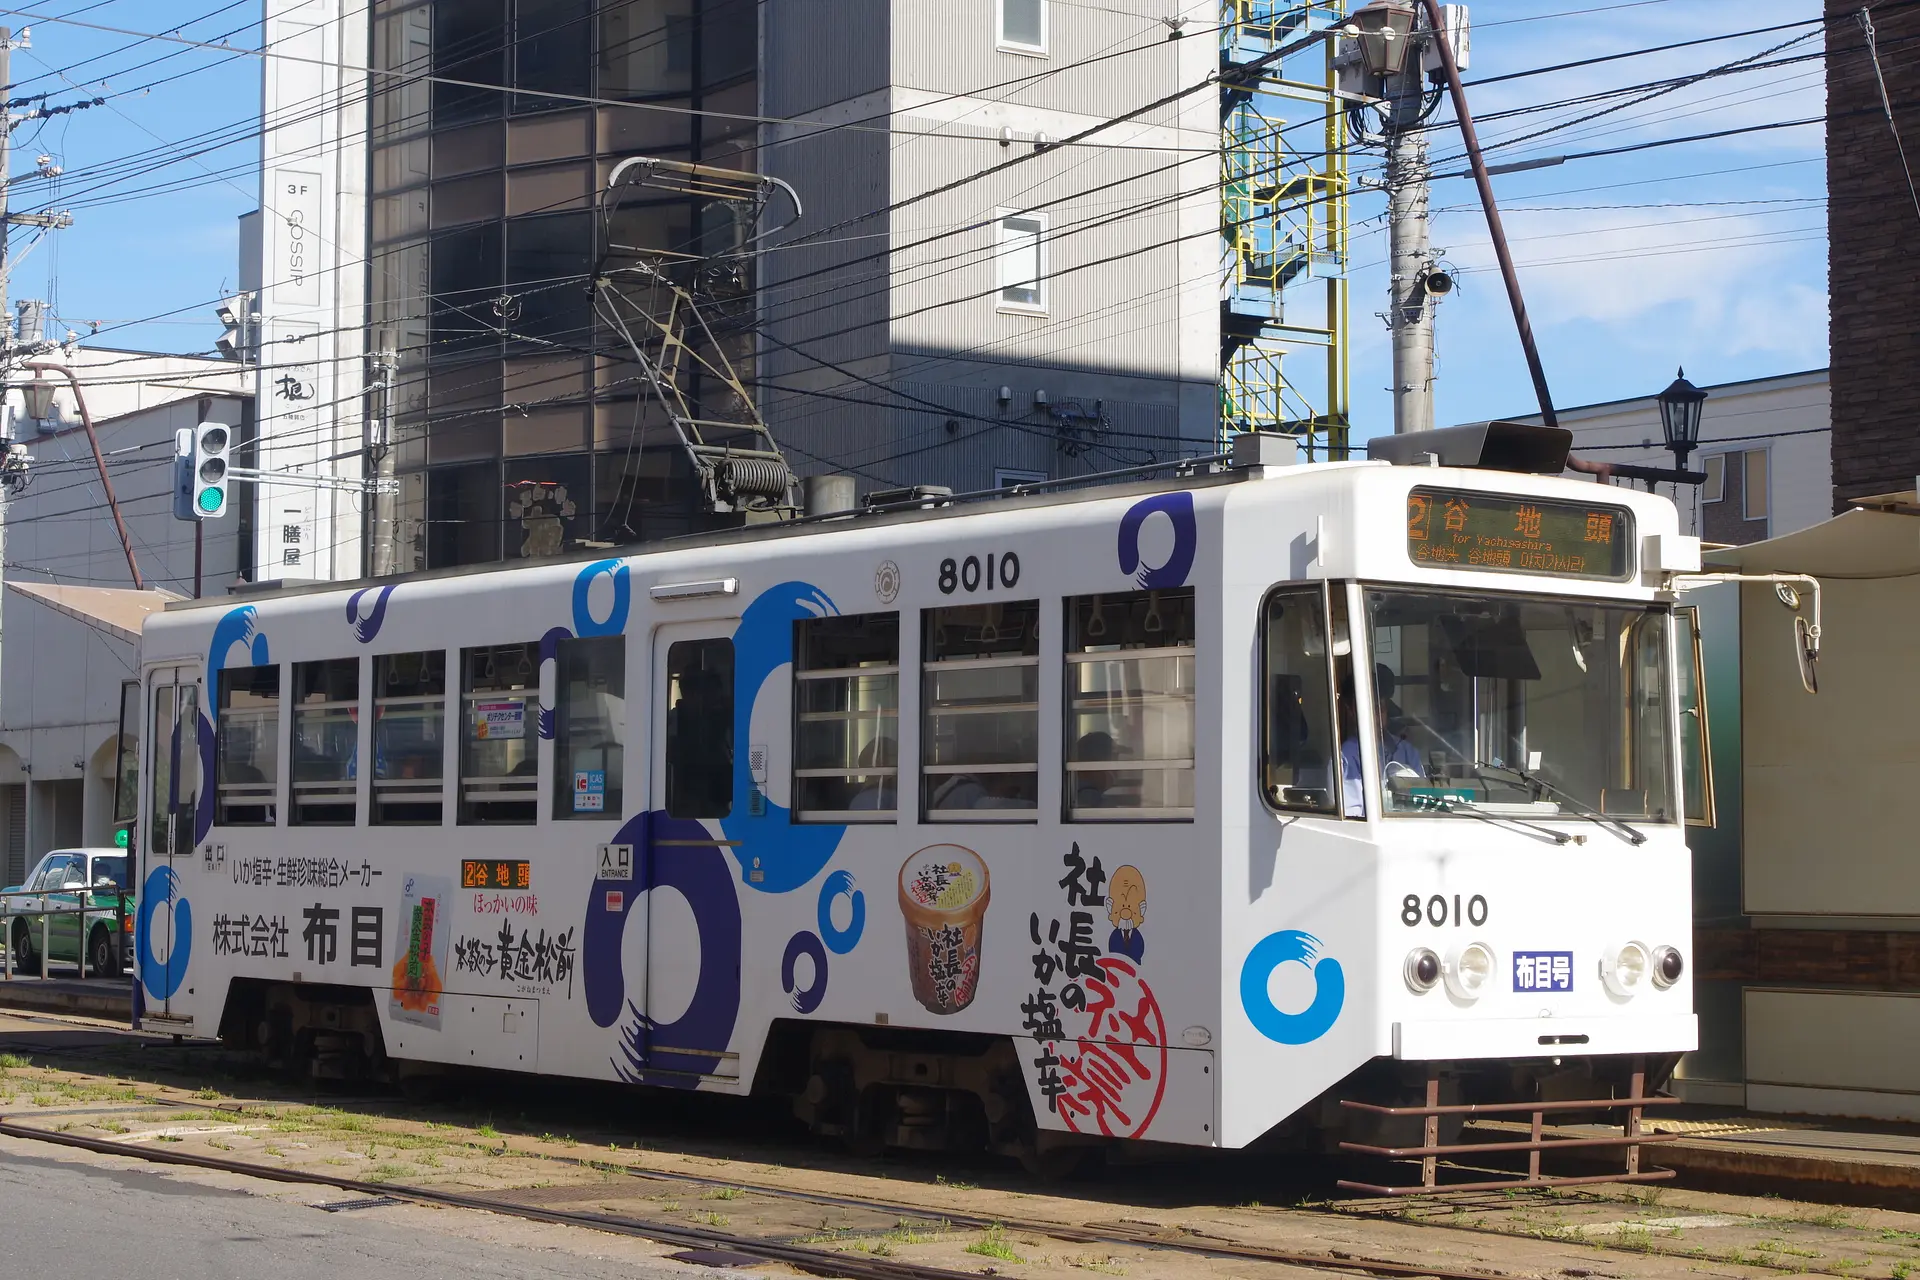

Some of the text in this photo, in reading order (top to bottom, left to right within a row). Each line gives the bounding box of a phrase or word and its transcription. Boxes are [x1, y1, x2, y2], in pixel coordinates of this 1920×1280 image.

[288, 184, 308, 195] 3F
[289, 209, 303, 286] GOSSIP
[283, 509, 301, 566] 一膳屋
[1443, 499, 1613, 544] 谷地頭
[938, 551, 1020, 595] 8010
[204, 845, 225, 862] 出口
[601, 847, 629, 867] 入口
[233, 857, 382, 888] いか塩辛・生鮮珍味総合メーカー
[475, 863, 530, 887] 谷地頭
[602, 869, 629, 878] ENTRANCE
[473, 893, 538, 917] ほっかいの味
[1400, 894, 1488, 927] 8010
[212, 913, 289, 958] 株式会社
[302, 903, 384, 969] 布目
[1058, 841, 1107, 1012] 社長の
[1516, 955, 1570, 989] 布目号
[1020, 911, 1067, 1114] いか塩辛
